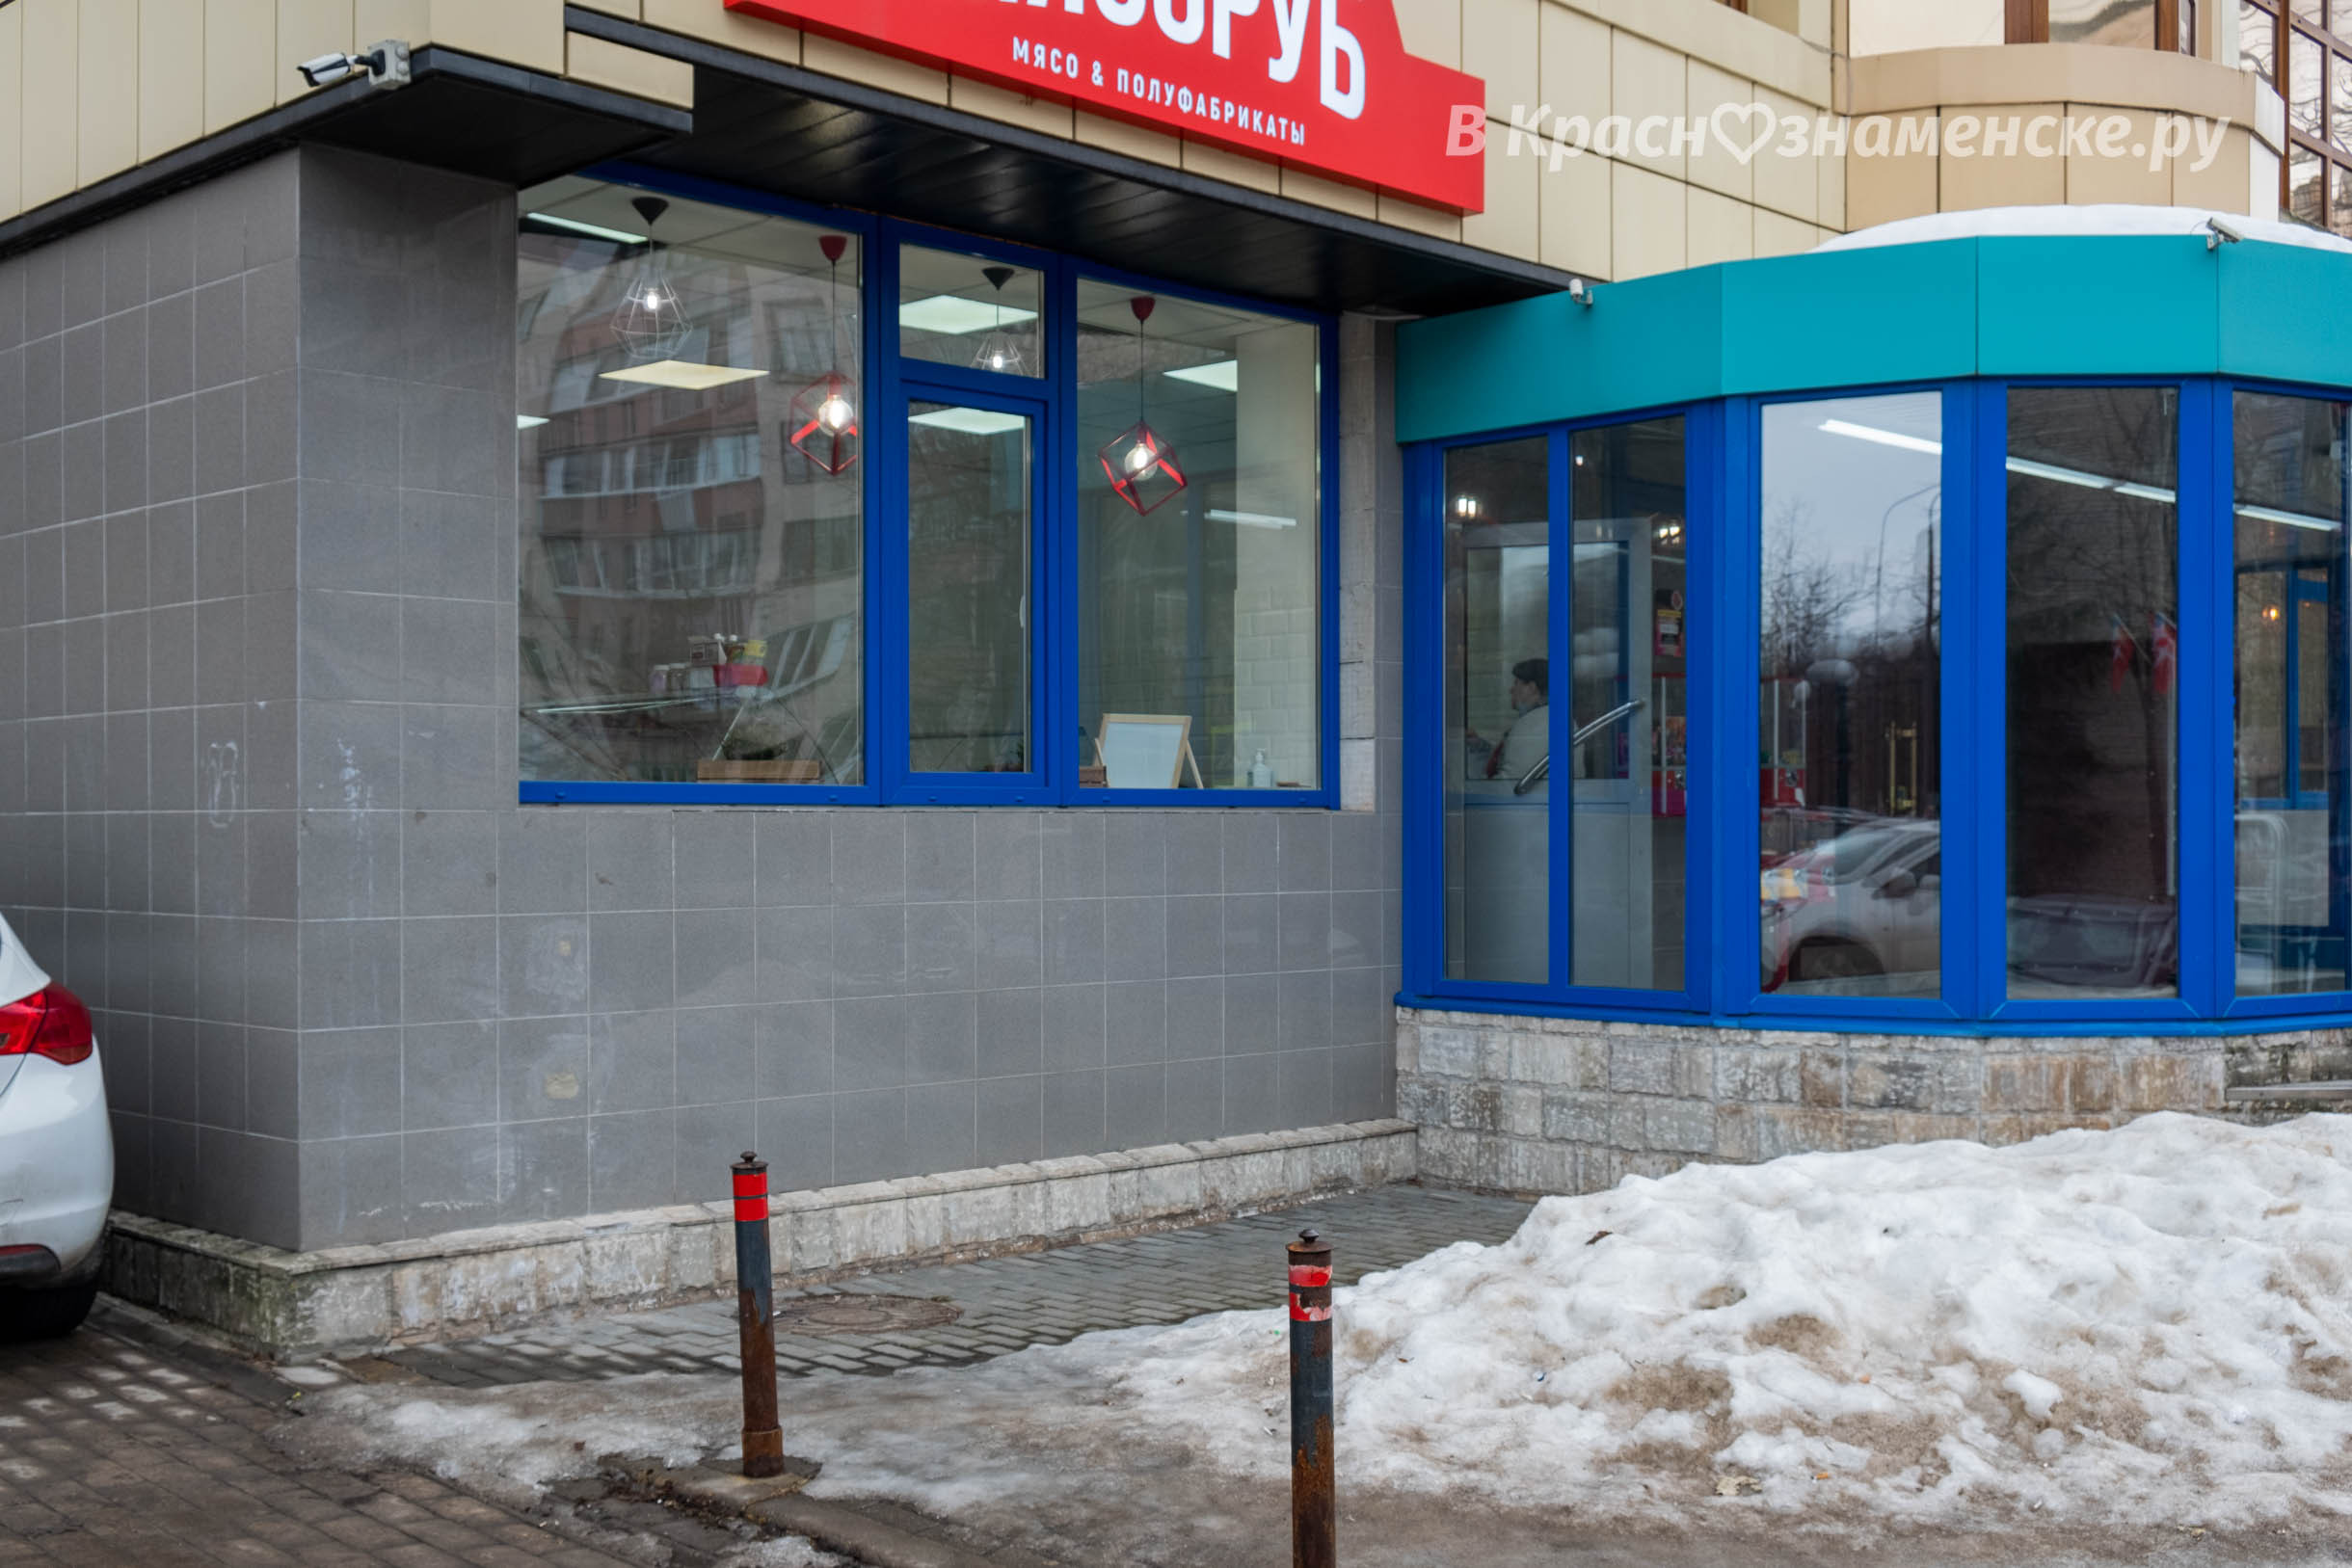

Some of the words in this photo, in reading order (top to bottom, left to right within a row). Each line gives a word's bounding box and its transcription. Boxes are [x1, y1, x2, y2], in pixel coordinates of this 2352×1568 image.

[1012, 36, 1079, 79] МЯСО
[1091, 60, 1105, 87] &
[1117, 68, 1305, 146] ПОЛУФАБРИКАТЫ
